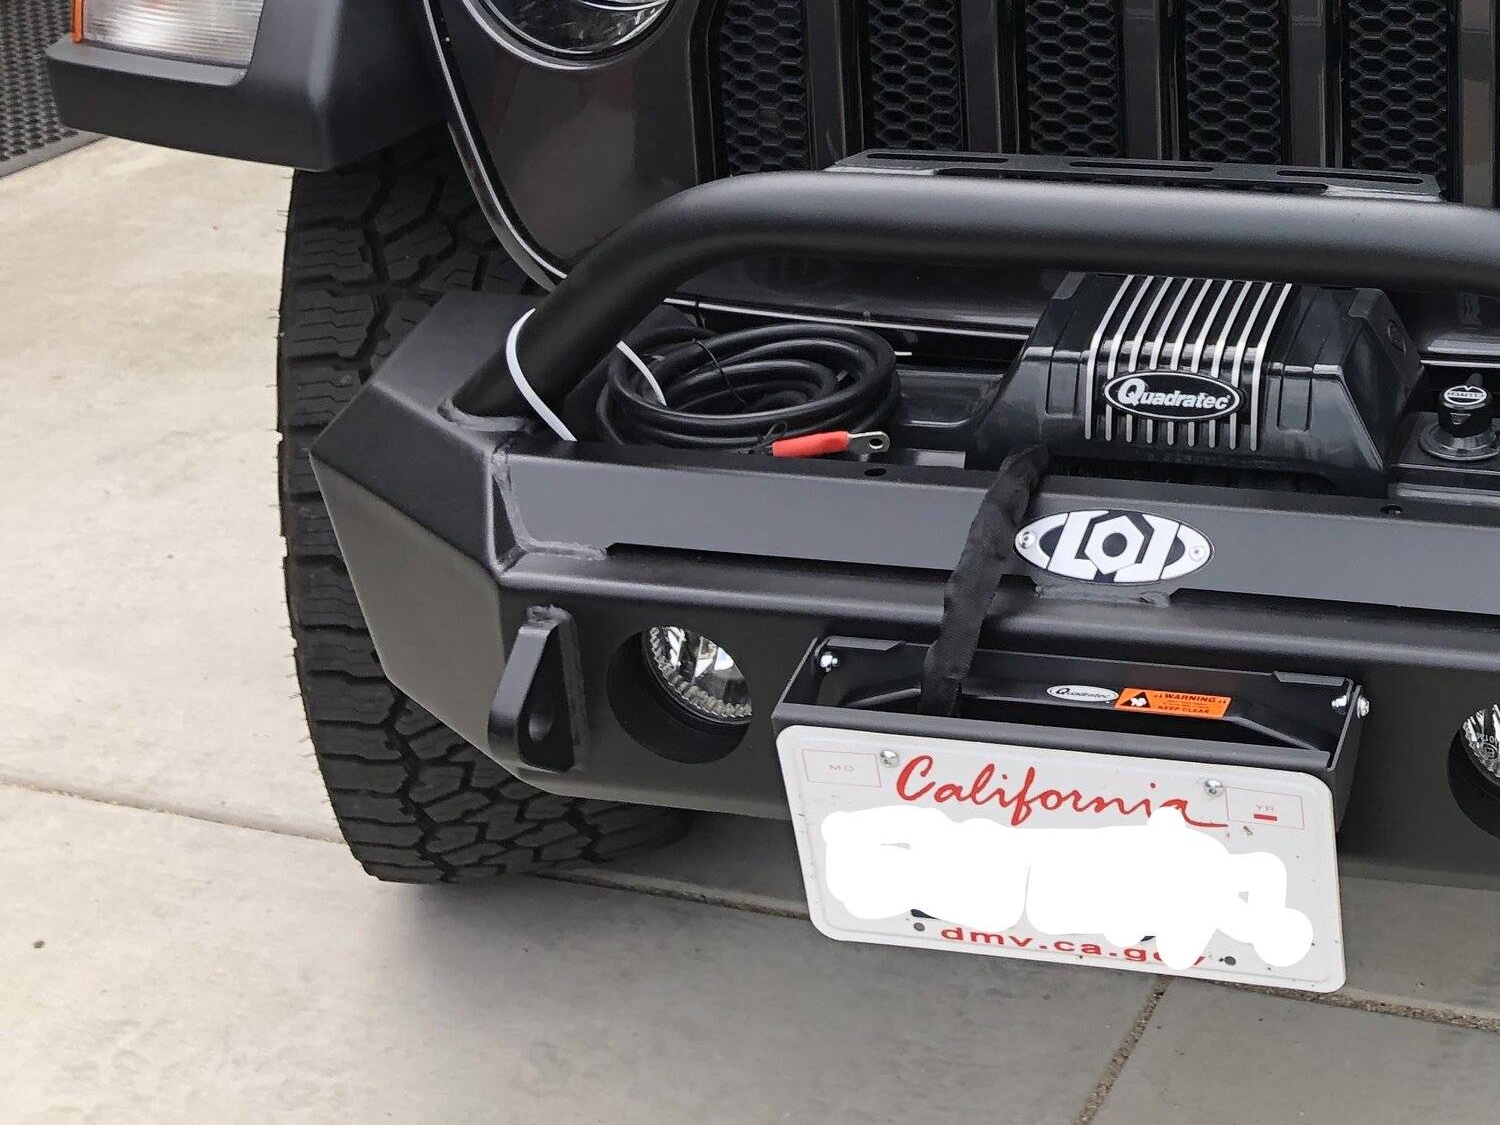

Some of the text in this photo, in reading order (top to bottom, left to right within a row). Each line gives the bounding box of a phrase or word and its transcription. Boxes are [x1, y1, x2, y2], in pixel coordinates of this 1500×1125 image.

[1117, 377, 1230, 410] Quadratec
[1164, 692, 1217, 703] WARNING
[940, 927, 1205, 967] dmv.ca.g
